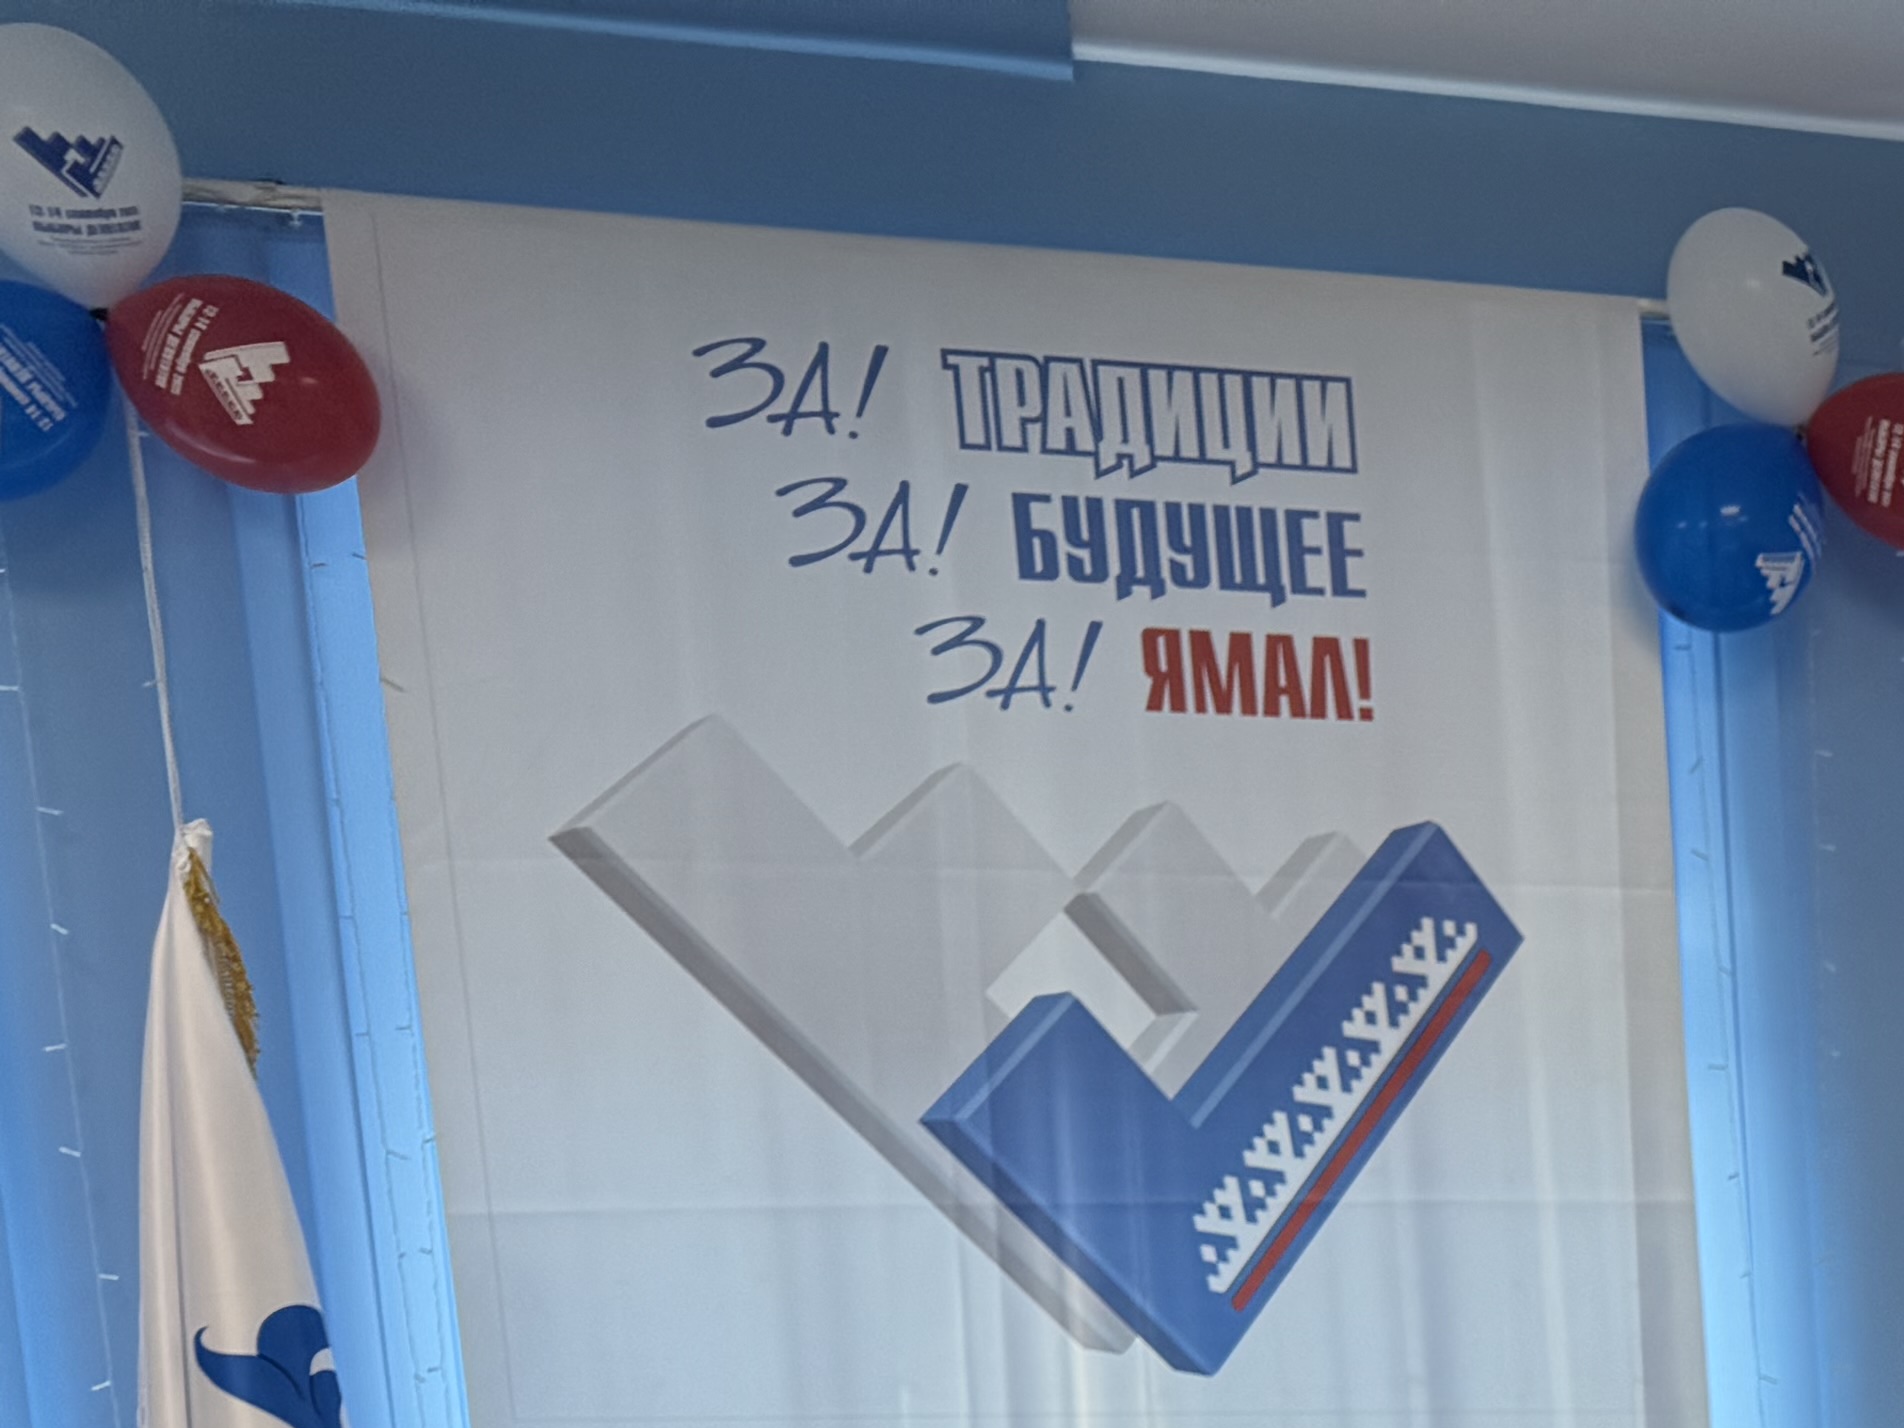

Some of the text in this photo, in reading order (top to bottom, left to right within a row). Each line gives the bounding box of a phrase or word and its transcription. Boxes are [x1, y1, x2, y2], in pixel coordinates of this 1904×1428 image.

[692, 337, 1359, 485] ЗА! ТРАДИЦИИ
[775, 476, 1367, 608] ЗА! БУДУЩЕЕ
[914, 615, 1375, 722] ЗА! ЯМАЛ!
